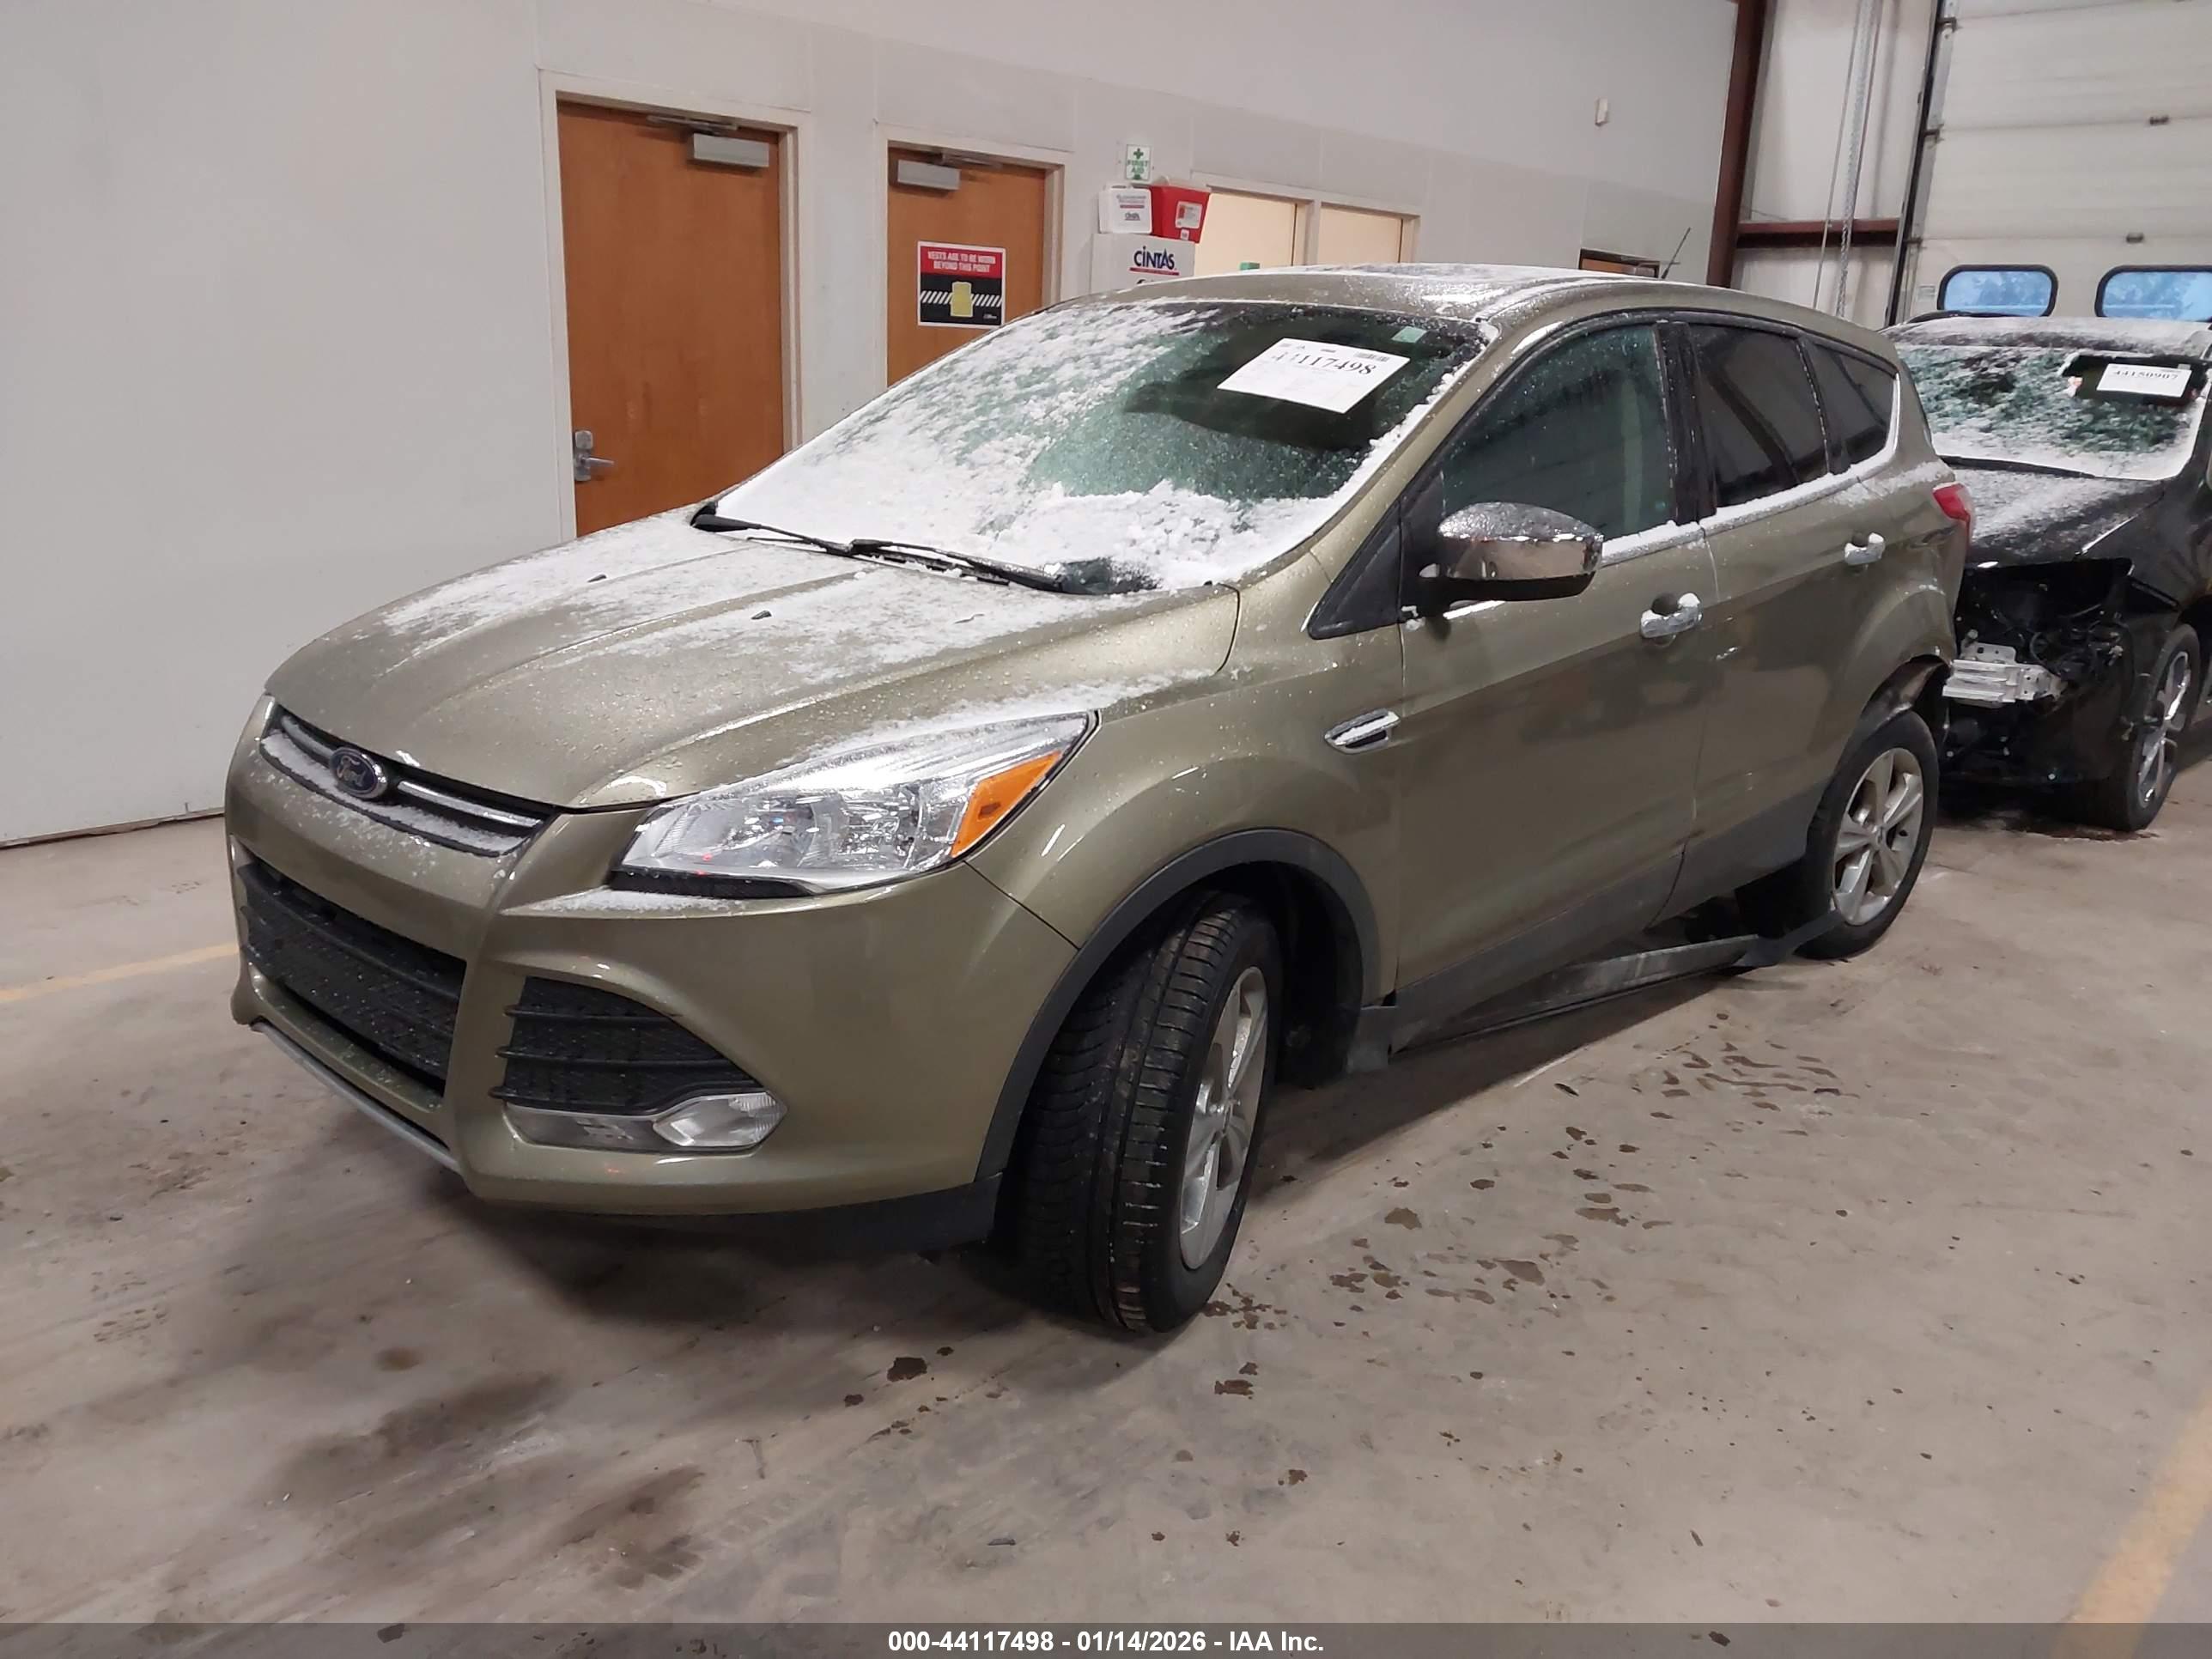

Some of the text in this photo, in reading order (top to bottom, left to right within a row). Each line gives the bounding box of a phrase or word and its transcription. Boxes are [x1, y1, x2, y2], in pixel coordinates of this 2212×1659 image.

[927, 252, 945, 260] VESTS
[947, 252, 959, 261] ARE
[960, 253, 969, 262] TO
[969, 254, 977, 263] BE
[1133, 246, 1175, 270] CINTAS
[933, 261, 990, 272] BEYOND THIS POINT
